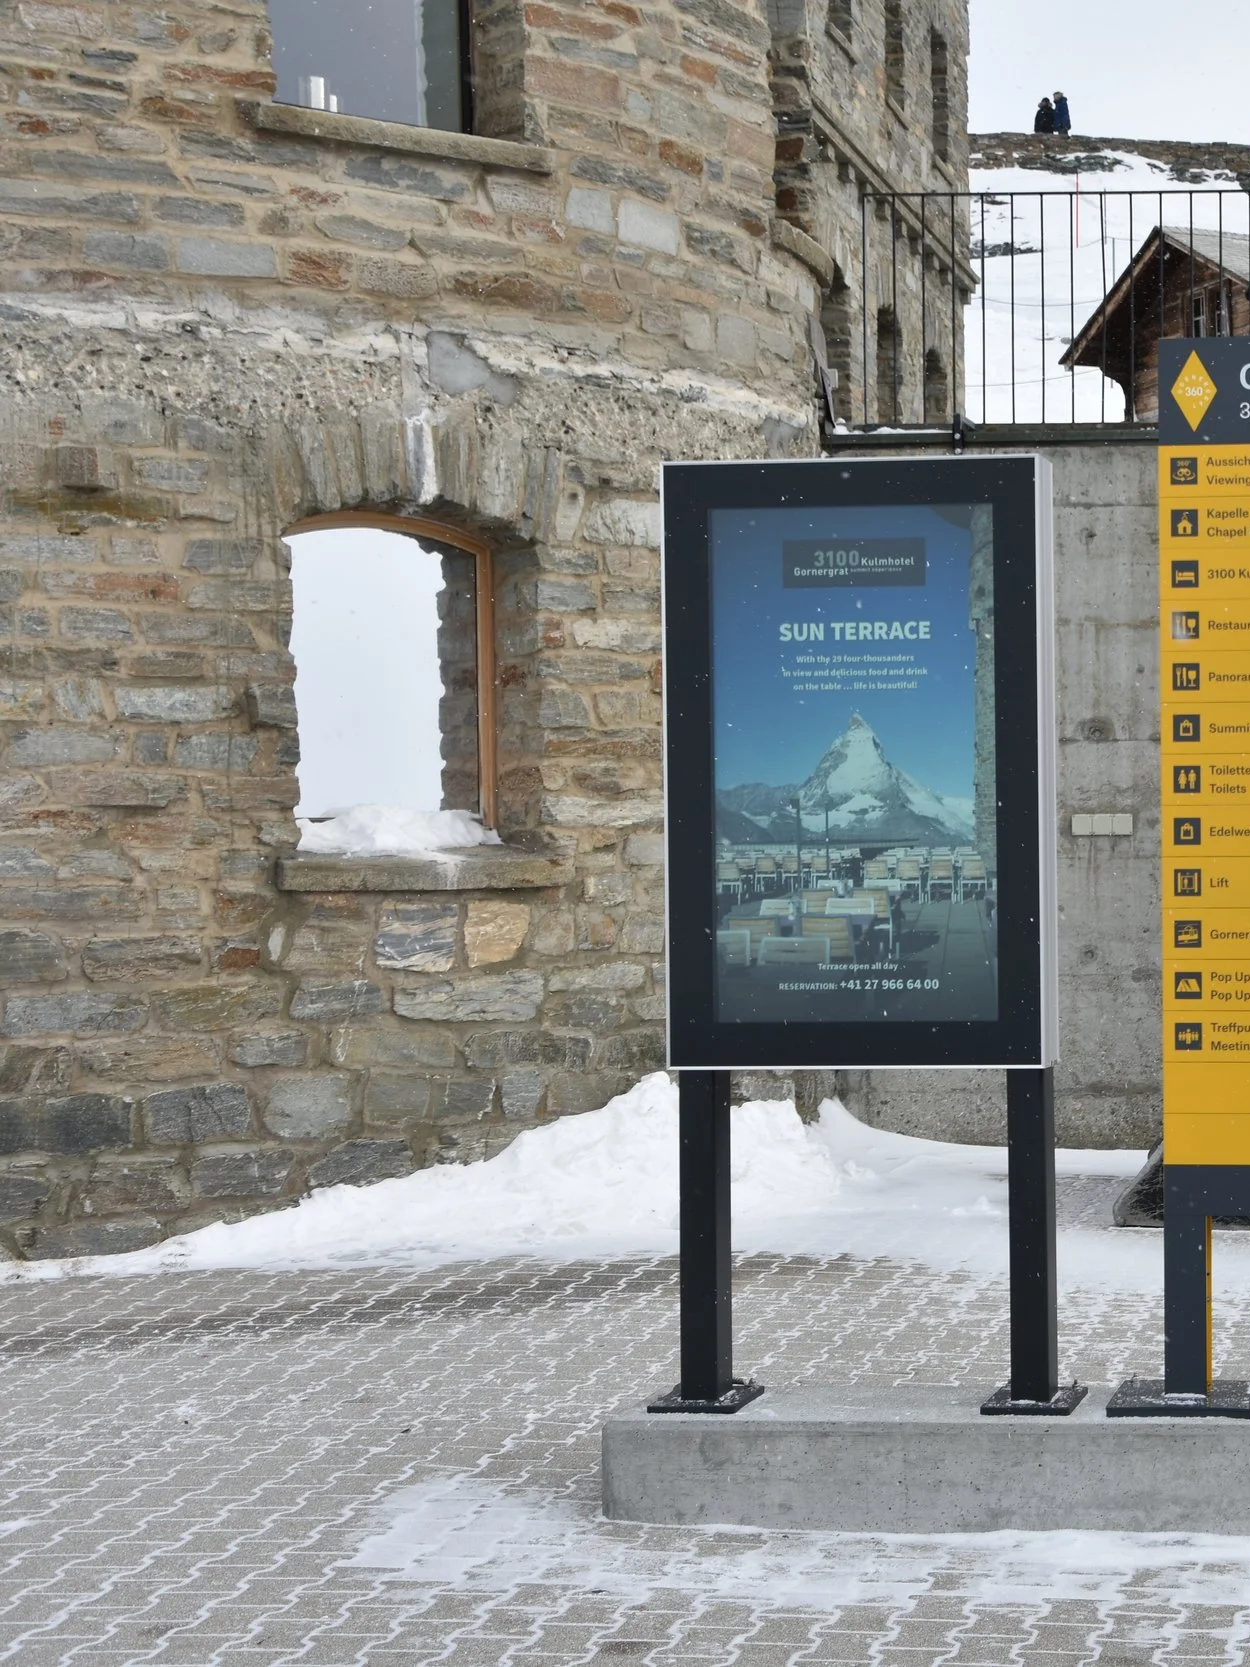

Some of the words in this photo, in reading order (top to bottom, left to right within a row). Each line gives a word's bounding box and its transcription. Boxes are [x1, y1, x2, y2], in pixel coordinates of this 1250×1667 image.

[1185, 387, 1203, 396] 360
[1207, 508, 1249, 520] Kapelle
[1207, 527, 1246, 539] Chapel
[814, 550, 860, 567] 3100
[861, 557, 914, 566] Kulmhotel
[794, 567, 848, 577] Gornergrat
[1208, 568, 1235, 580] 3100
[779, 623, 824, 642] SUN
[830, 621, 931, 641] TERRACE
[796, 655, 816, 664] With
[818, 656, 830, 664] the
[832, 655, 842, 663] 29
[843, 654, 914, 663] four-thousanders
[792, 669, 812, 677] view
[813, 668, 829, 677] and
[831, 668, 867, 677] delicious
[868, 668, 887, 676] food
[888, 668, 904, 676] and
[906, 667, 928, 676] drink
[805, 682, 819, 690] the
[820, 682, 841, 690] table
[854, 681, 867, 690] life
[868, 681, 876, 689] is
[877, 680, 917, 689] beautiful!
[1210, 783, 1246, 794] Toilets
[1210, 878, 1229, 888] Lift
[849, 964, 869, 972] open
[883, 962, 898, 972] day
[1210, 972, 1232, 984] Pop
[1235, 972, 1250, 984] Up
[779, 983, 838, 991] RESERVATION:
[840, 980, 861, 990] +41
[864, 980, 878, 990] 27
[882, 979, 904, 990] 966
[907, 979, 921, 989] 64
[924, 979, 939, 989] 00
[1210, 990, 1232, 1003] Pop
[1235, 990, 1250, 1002] Up
